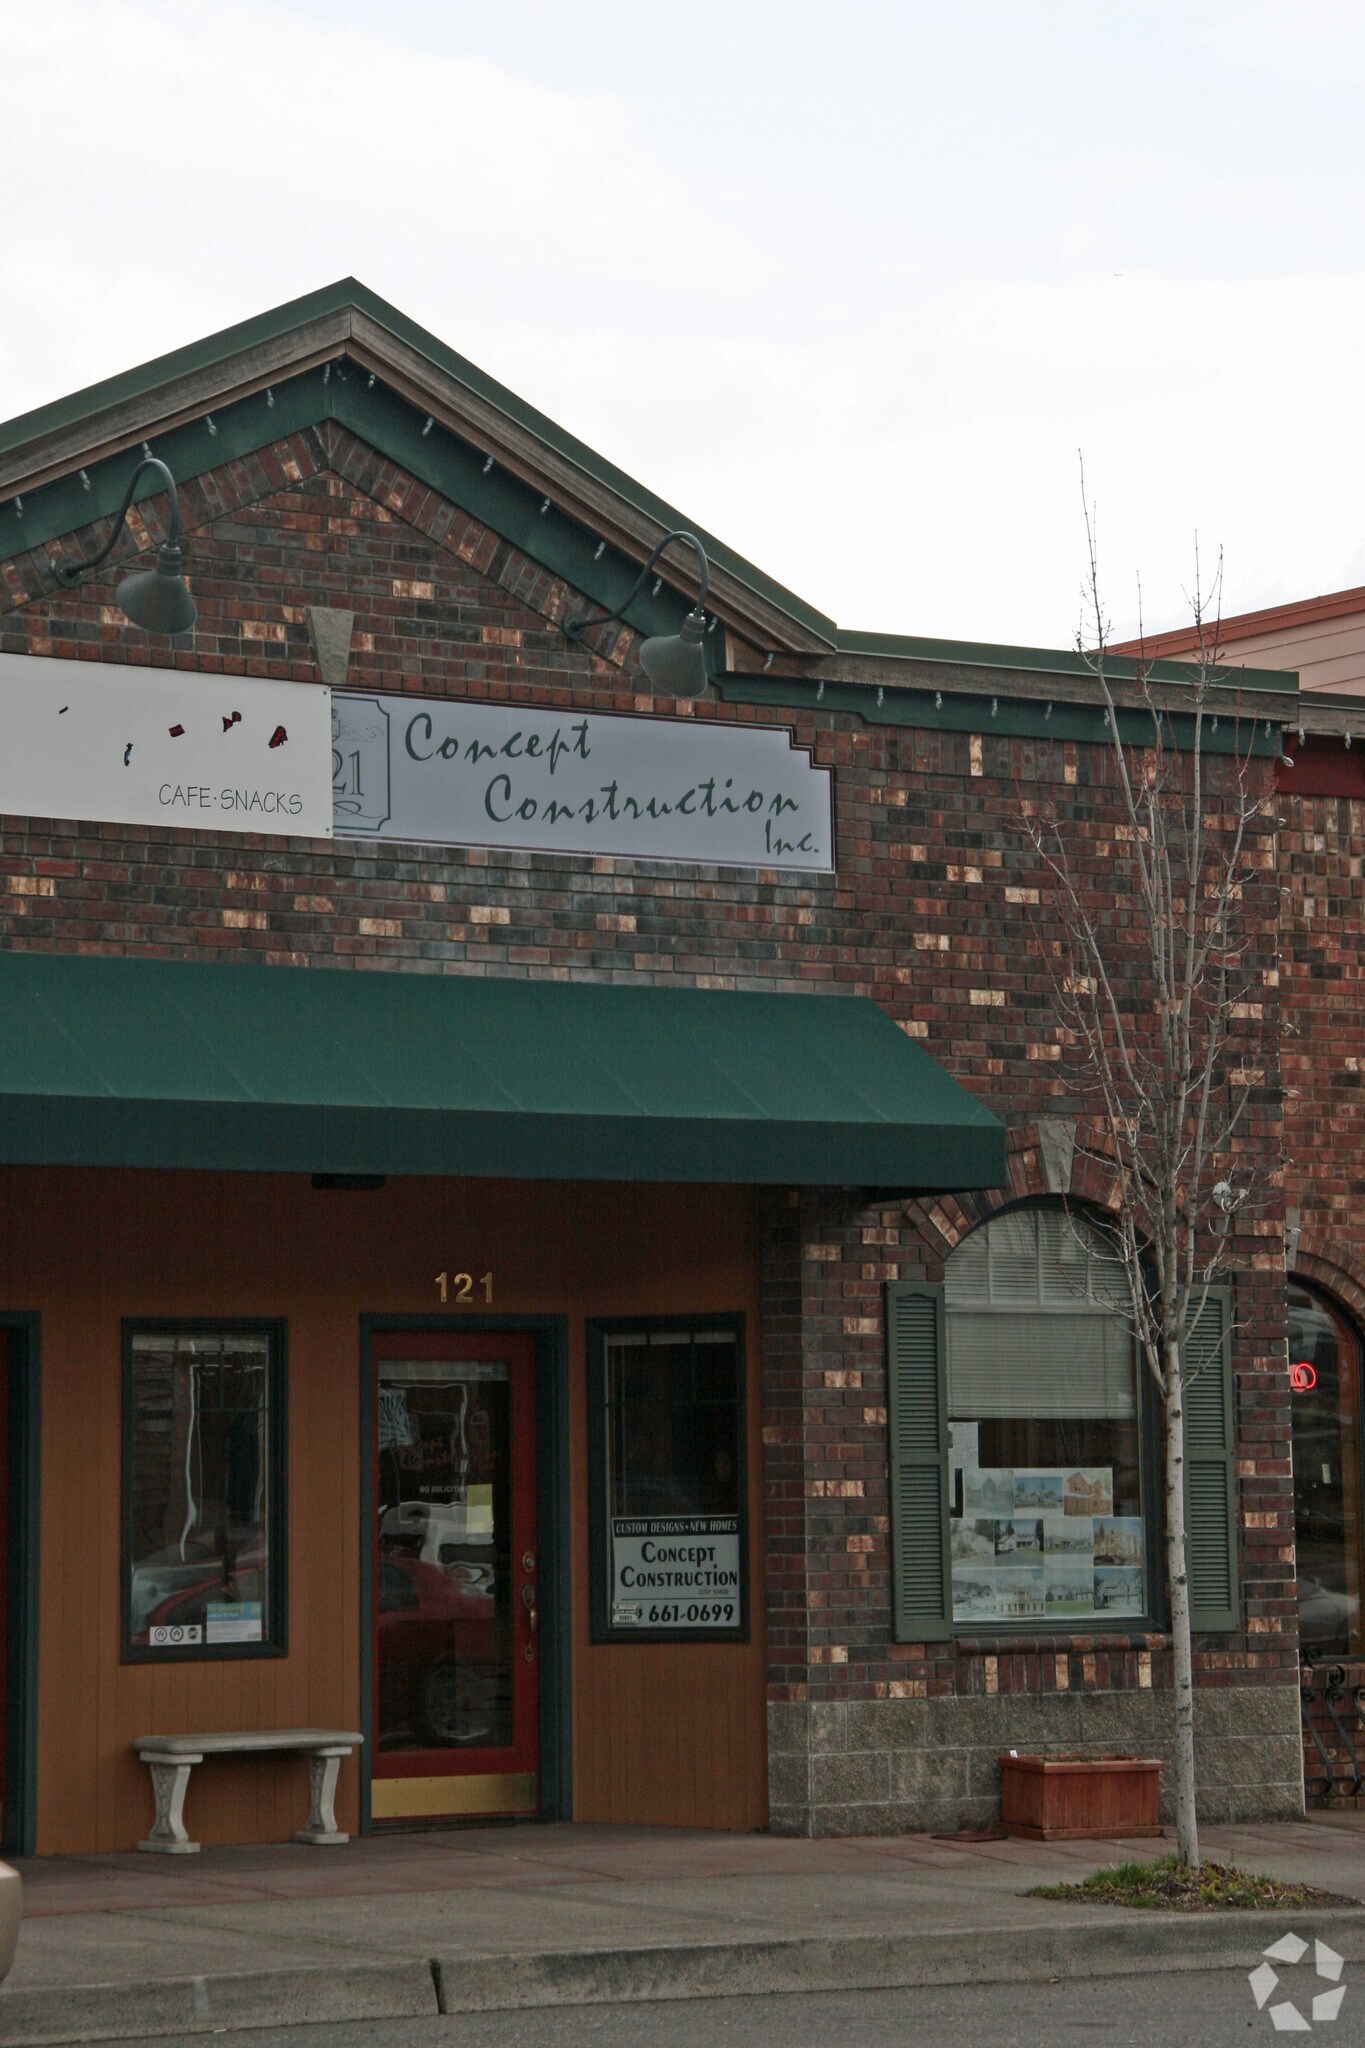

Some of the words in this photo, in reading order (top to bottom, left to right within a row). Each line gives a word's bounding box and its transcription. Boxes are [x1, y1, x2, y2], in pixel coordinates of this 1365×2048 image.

[404, 712, 591, 775] Concept
[332, 748, 365, 797] 21
[484, 773, 800, 825] Construction
[764, 819, 820, 856] Inc.
[435, 1271, 493, 1303] 121
[419, 1485, 430, 1493] NO
[431, 1485, 465, 1493] SOLICITIN
[616, 1522, 648, 1534] CUSTOM
[650, 1521, 685, 1533] DESIGNS
[689, 1520, 707, 1532] NEW
[709, 1519, 738, 1531] HOMES
[648, 1604, 734, 1623] 661-0699
